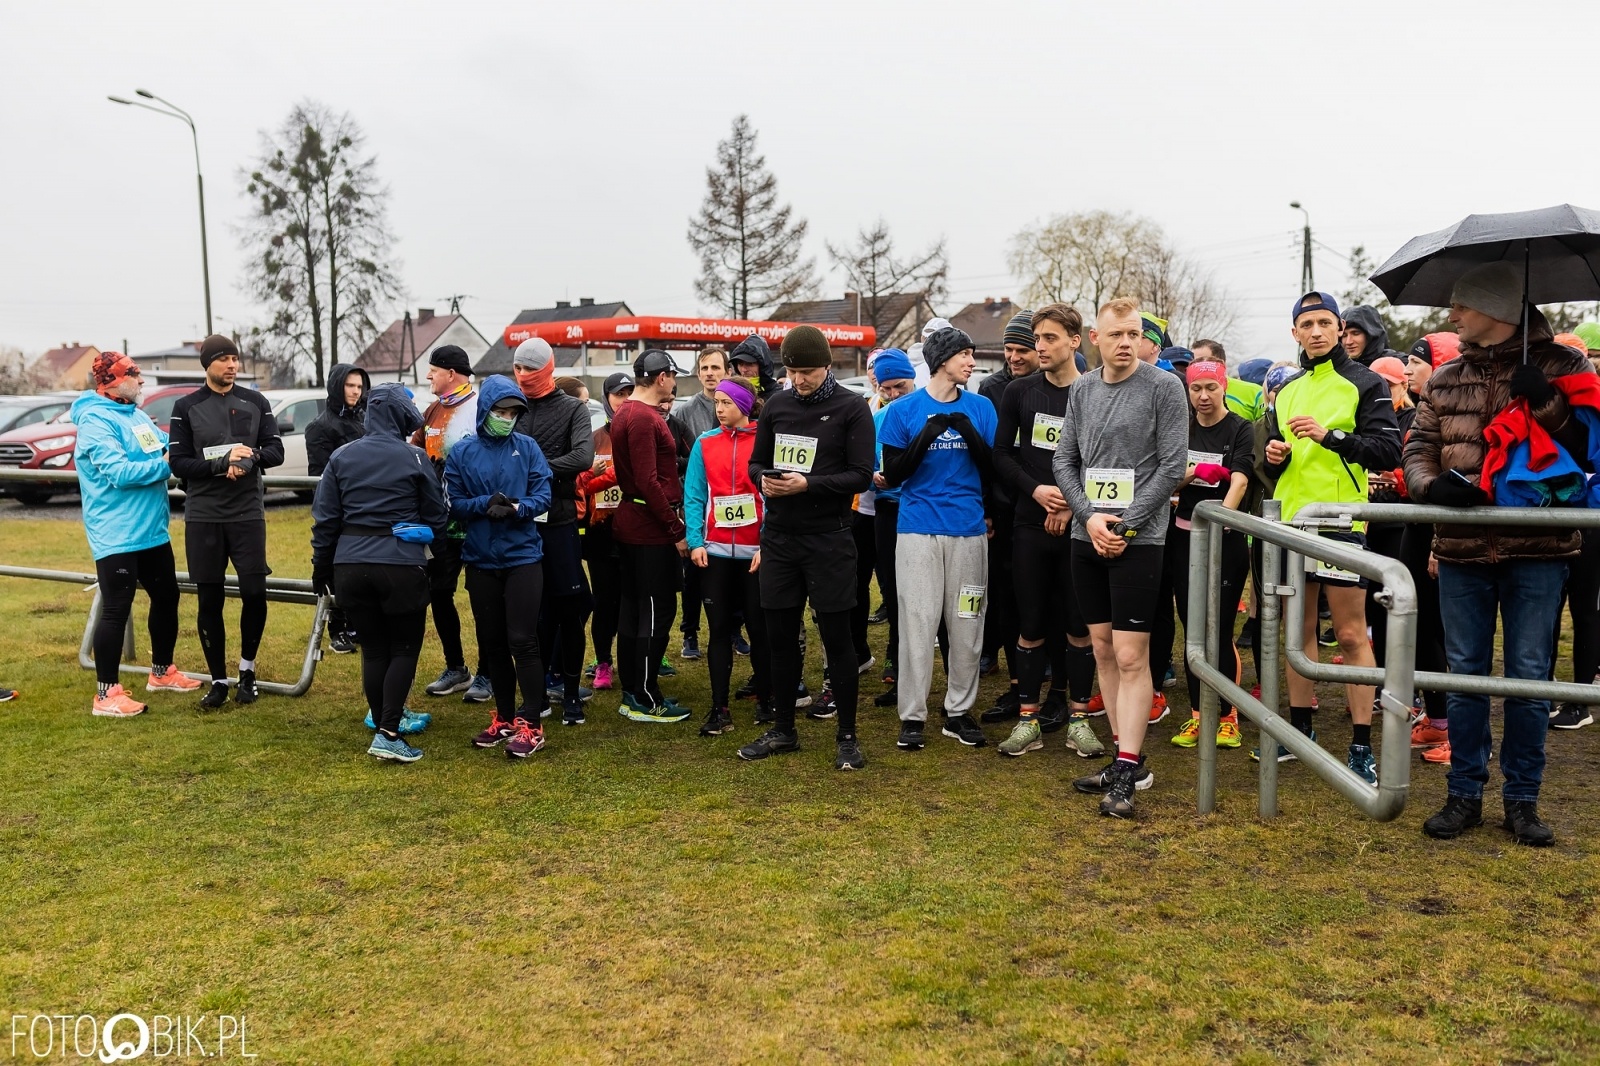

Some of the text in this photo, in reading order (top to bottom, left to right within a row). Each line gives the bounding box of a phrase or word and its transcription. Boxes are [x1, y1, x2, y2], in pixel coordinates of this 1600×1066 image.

[566, 325, 583, 339] 24h
[659, 322, 756, 338] samoobsługowa
[758, 325, 791, 340] myjni
[938, 441, 952, 450] CAŁE
[780, 446, 808, 465] 116
[603, 488, 619, 502] 88
[1095, 481, 1119, 500] 73
[725, 505, 746, 521] 64
